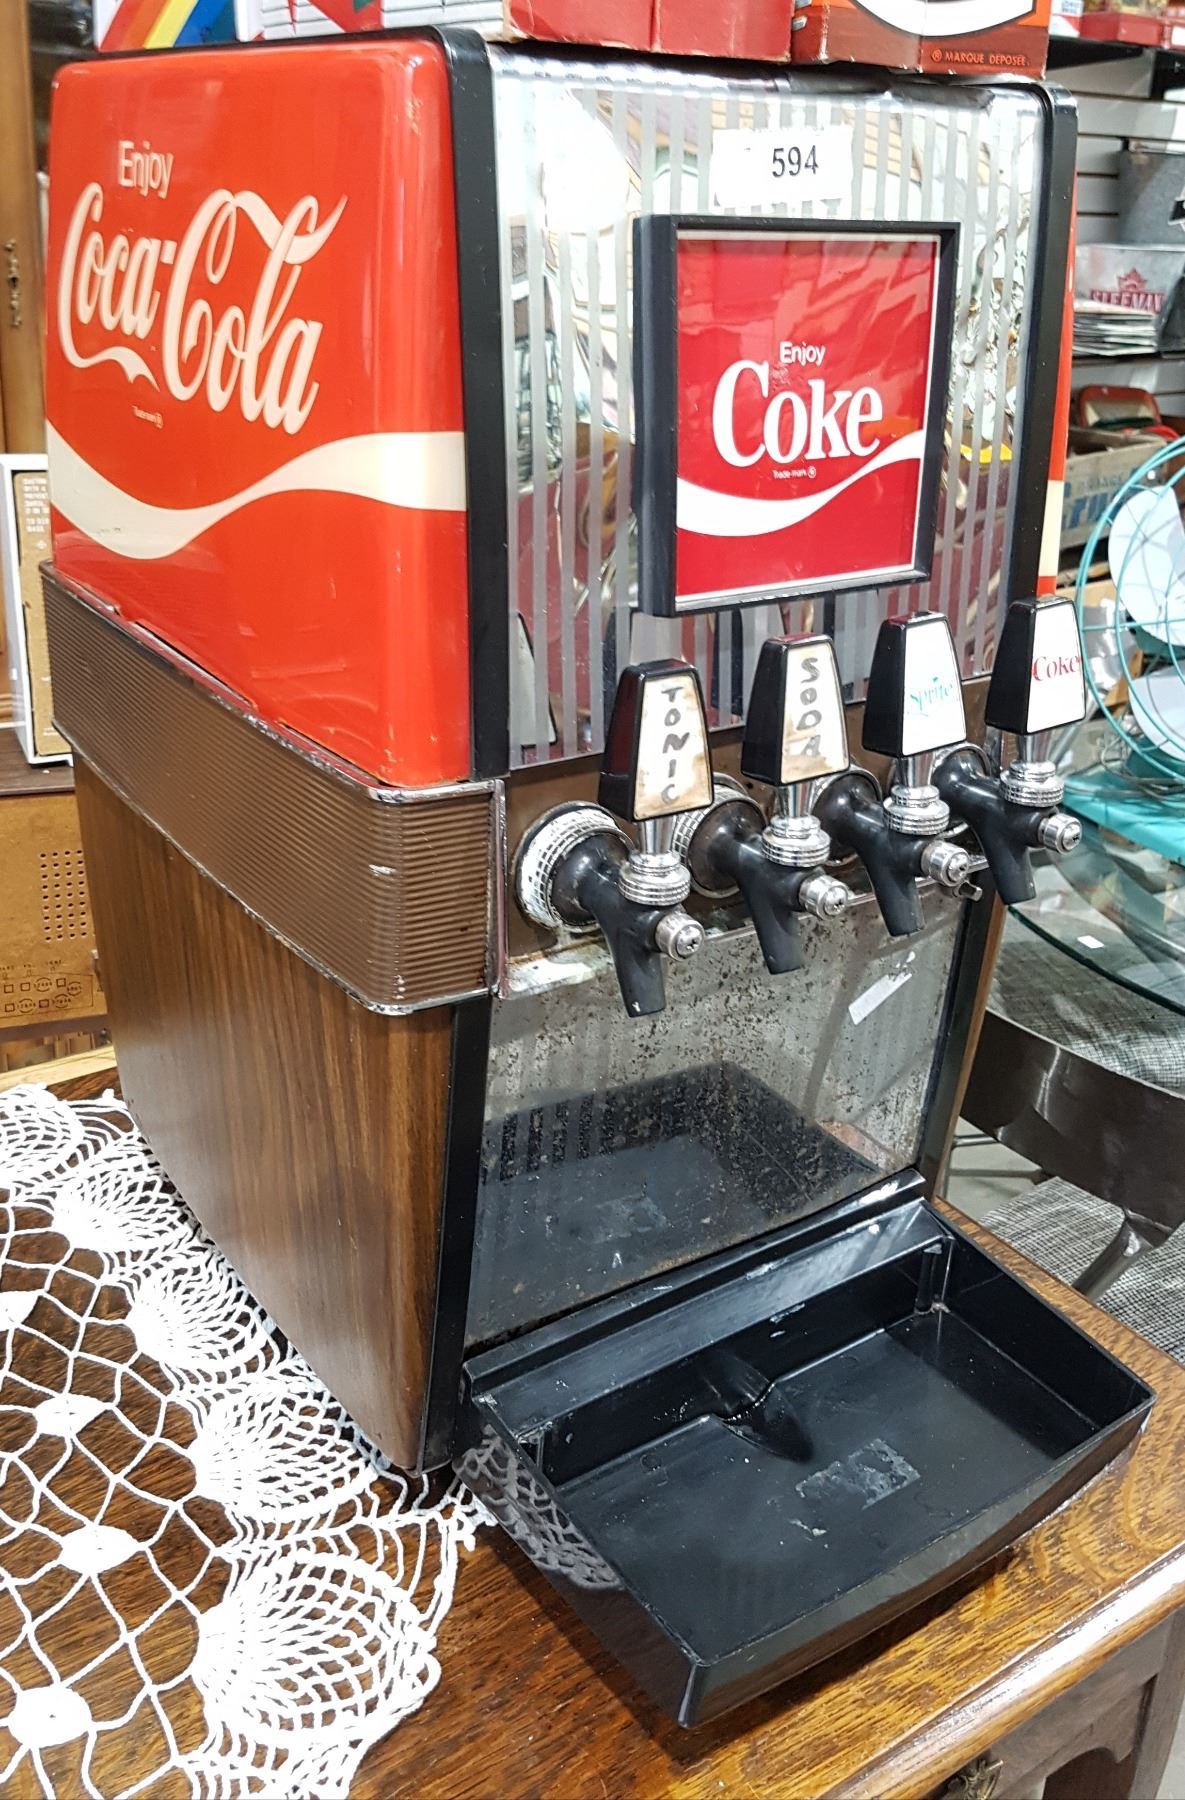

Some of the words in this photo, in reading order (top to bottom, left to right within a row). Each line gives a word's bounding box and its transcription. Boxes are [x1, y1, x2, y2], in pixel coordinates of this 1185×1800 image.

[945, 50, 985, 65] MARQUE
[117, 139, 175, 200] Enjoy
[771, 144, 820, 179] 594
[57, 181, 349, 436] Coca-Cola
[778, 340, 827, 367] Enjoy
[712, 358, 884, 469] Coke
[1031, 655, 1082, 682] Coke
[796, 656, 824, 758] SODA
[908, 676, 954, 714] Sprite
[660, 685, 691, 805] TONIC
